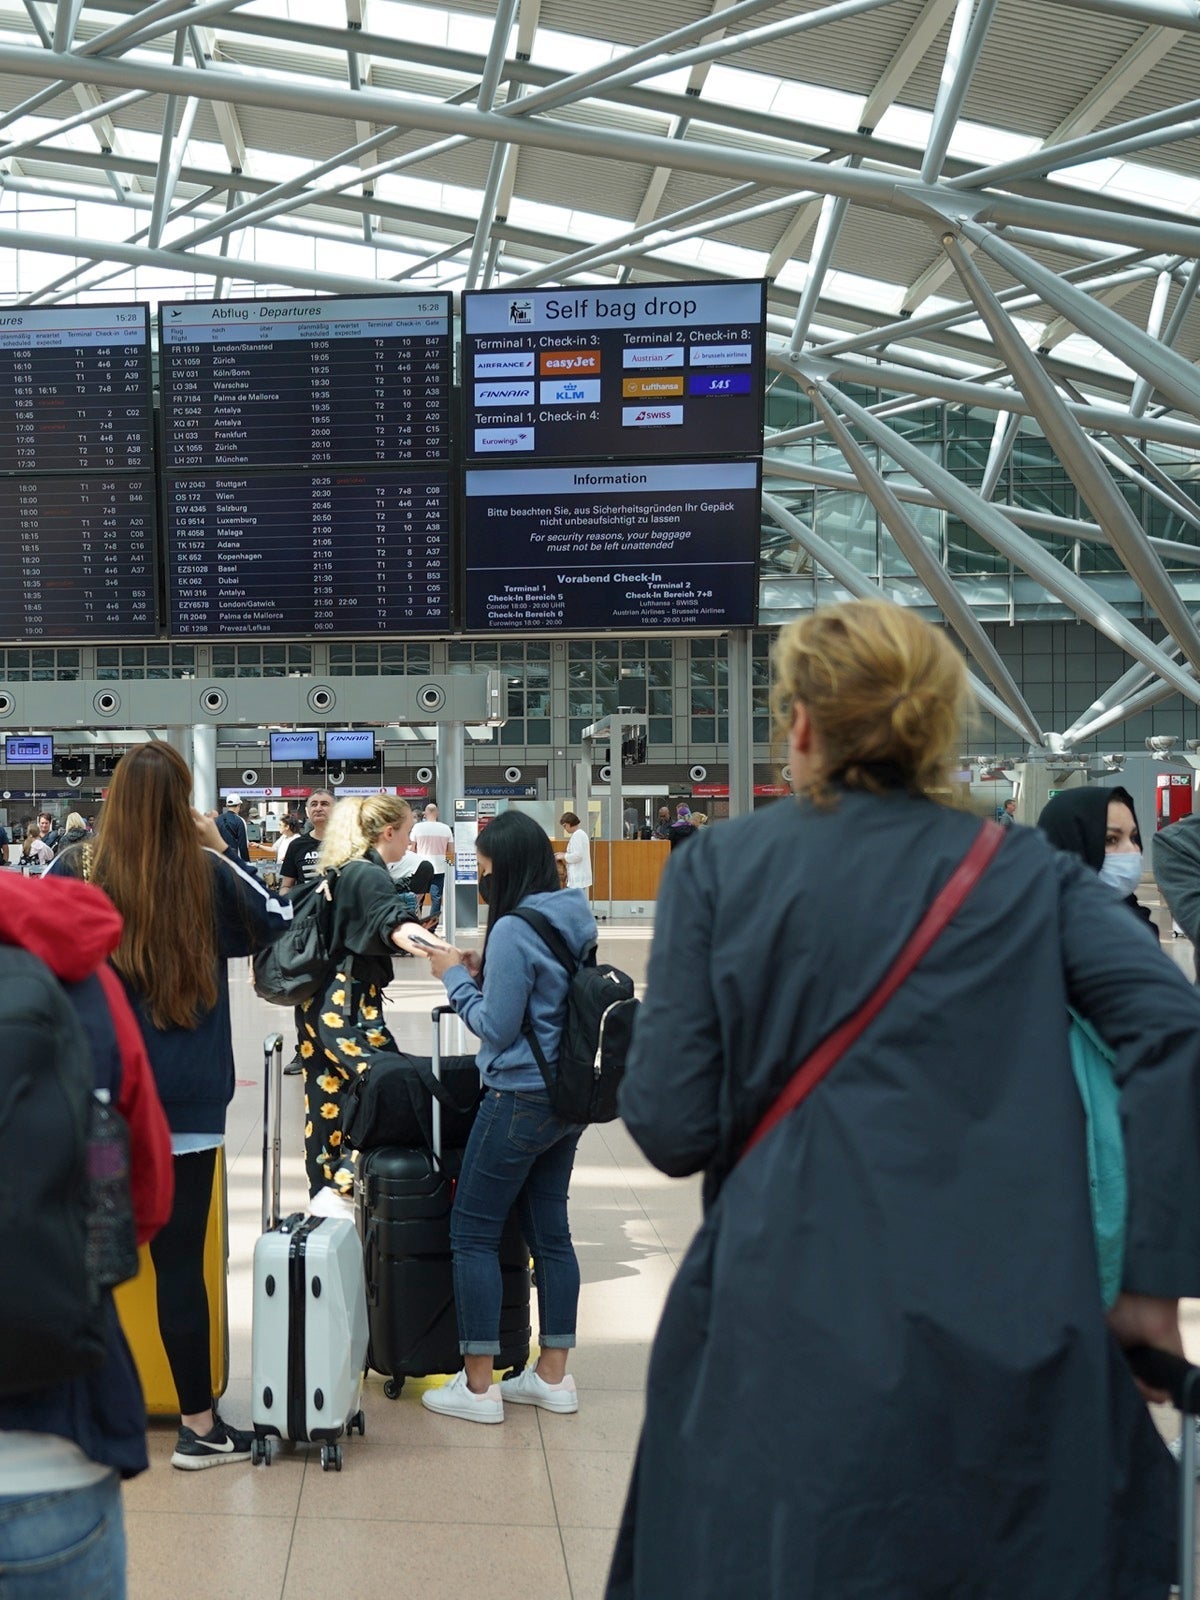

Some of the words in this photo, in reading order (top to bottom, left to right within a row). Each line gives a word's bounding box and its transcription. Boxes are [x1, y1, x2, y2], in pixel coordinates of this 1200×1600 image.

[212, 308, 249, 320] Abflug
[260, 306, 321, 318] Departures
[418, 304, 439, 312] 15:28
[546, 300, 589, 319] Self
[596, 299, 636, 320] bag
[645, 296, 697, 318] drop
[116, 314, 137, 322] 15:28
[624, 333, 672, 344] Terminal
[676, 332, 685, 343] 2,
[689, 330, 737, 342] Check-in
[741, 330, 751, 339] 8:
[213, 343, 273, 351] London/Stansted
[475, 338, 523, 349] Terminal
[527, 338, 536, 348] 1,
[539, 336, 587, 347] Check-in
[590, 336, 600, 345] 3:
[213, 357, 235, 365] Zürich
[632, 354, 663, 362] Austrian
[546, 357, 595, 369] easyJet
[213, 369, 250, 377] Köln/Bonn
[641, 382, 678, 391] Lufthansa
[709, 380, 730, 389] SAS
[479, 390, 530, 398] FINNAIR
[556, 391, 584, 400] KLM
[475, 413, 523, 423] Terminal
[527, 412, 536, 423] 1,
[539, 410, 587, 422] Check-in
[589, 411, 600, 420] 4:
[311, 428, 330, 436] 20:00
[482, 437, 518, 445] Eurowings
[573, 473, 647, 485] Information
[217, 505, 247, 513] Salzburg
[487, 507, 508, 516] Bitte
[510, 506, 551, 516] beachten
[554, 506, 571, 515] Sie,
[574, 507, 590, 515] aus
[593, 503, 682, 515] Sicherheitsgründen
[685, 503, 697, 511] Ihr
[700, 502, 734, 513] Gepäck
[217, 516, 257, 525] Luxemburg
[540, 517, 562, 526] nicht
[565, 515, 635, 526] unbeaufsichtigt
[651, 515, 680, 523] lassen
[217, 529, 243, 537] Malaga
[530, 533, 545, 542] For
[548, 533, 583, 543] security
[586, 532, 624, 541] reasons,
[627, 531, 649, 541] your
[651, 530, 691, 541] baggage
[547, 543, 570, 552] must
[572, 543, 588, 551] not
[590, 542, 602, 551] be
[604, 541, 619, 550] left
[622, 540, 673, 549] unattended
[218, 553, 262, 561] Kopenhagen
[557, 574, 609, 584] Vorabend
[613, 573, 662, 582] Check-In
[219, 589, 245, 597] Antalya
[525, 787, 536, 795] ah
